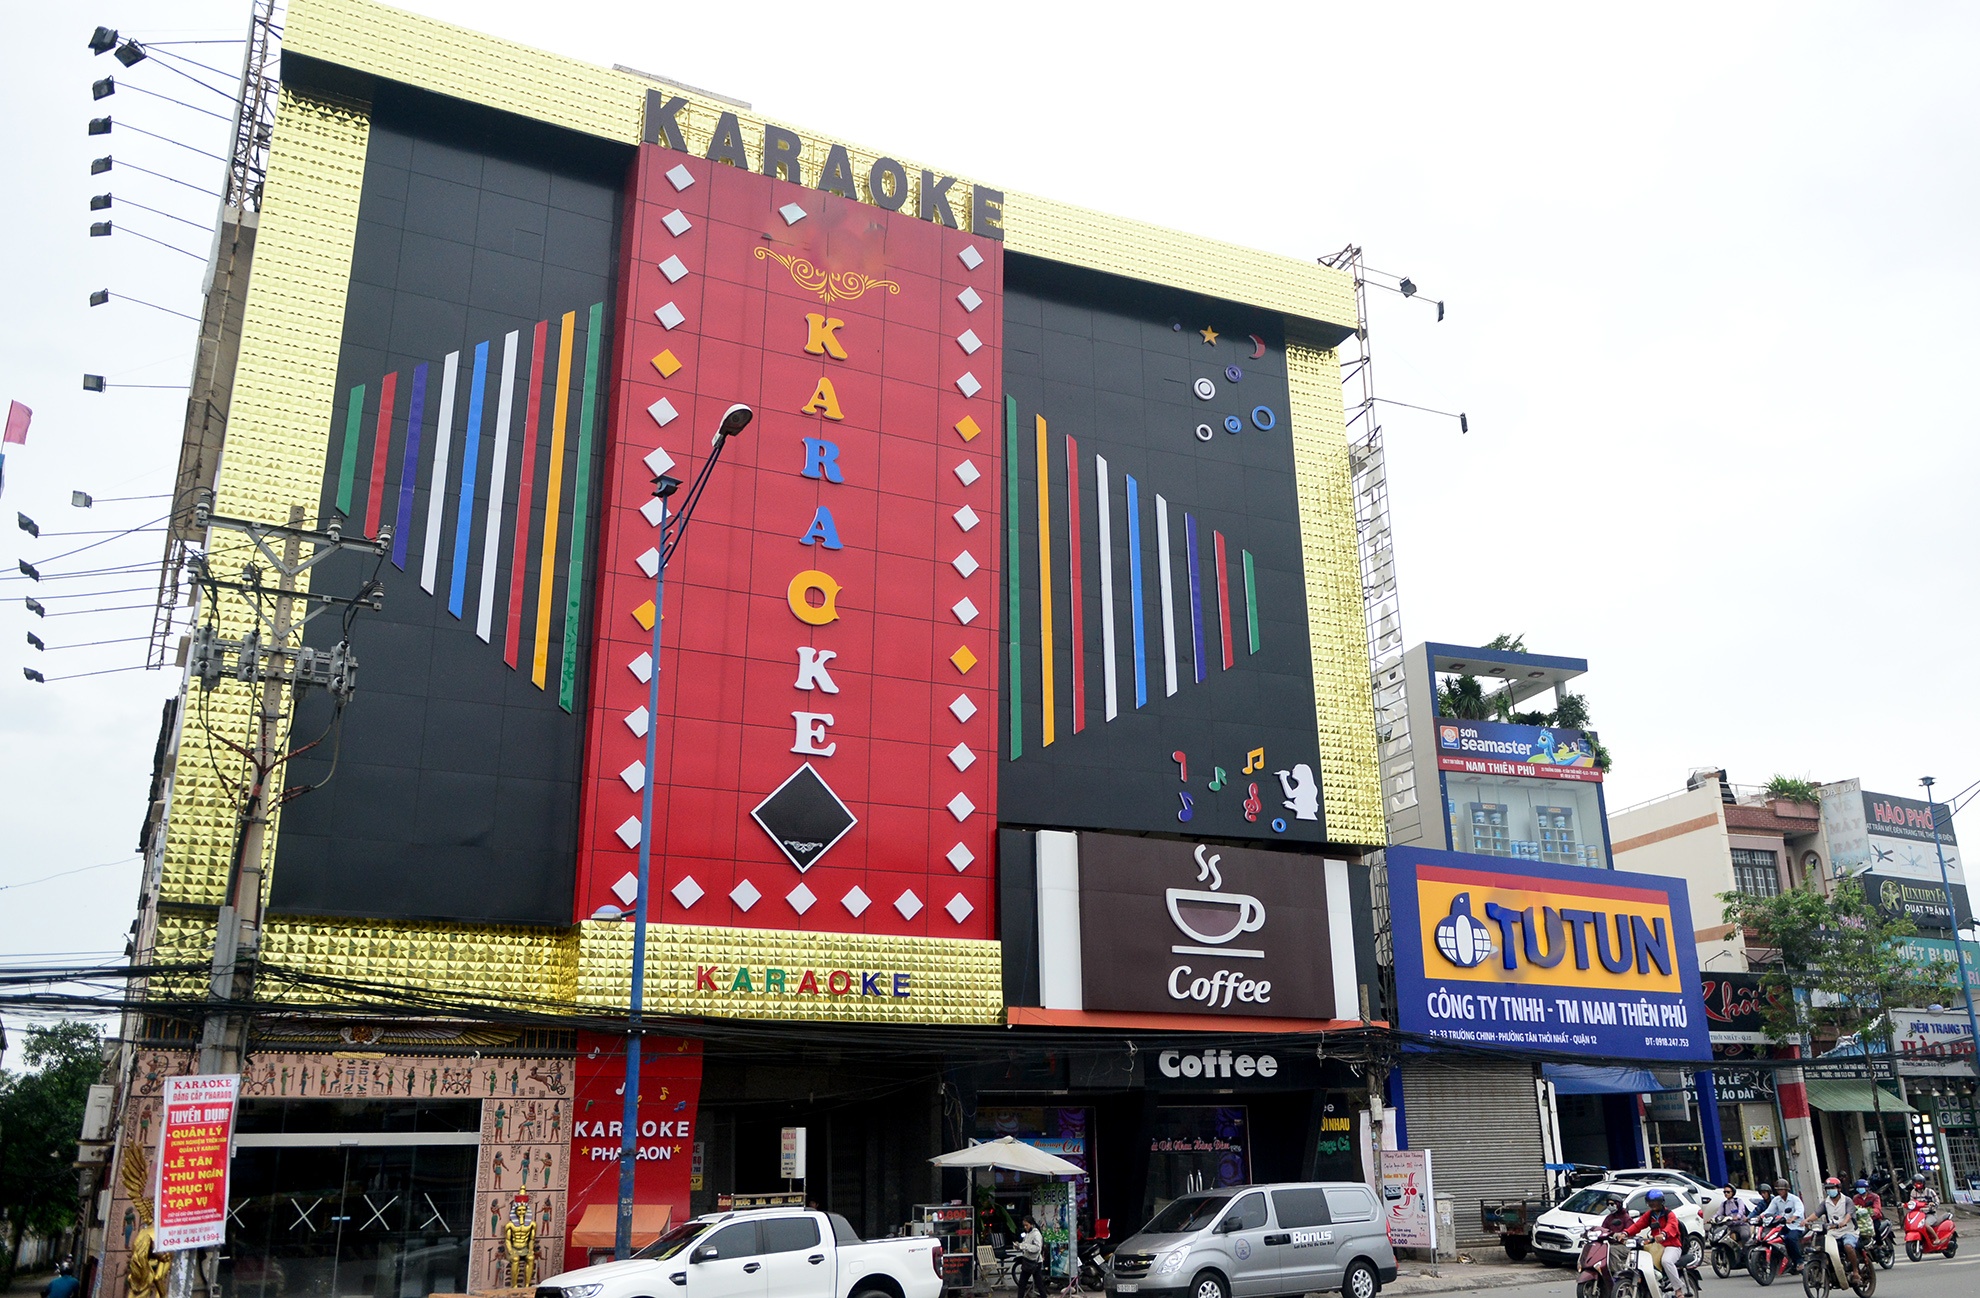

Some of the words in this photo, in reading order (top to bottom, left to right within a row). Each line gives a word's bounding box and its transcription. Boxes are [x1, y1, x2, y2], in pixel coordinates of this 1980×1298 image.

[642, 88, 1004, 241] KARAOKE
[786, 312, 848, 757] KARAOKE
[1460, 728, 1478, 738] sơn
[1461, 739, 1532, 755] seamaster
[1465, 761, 1486, 772] NAM
[1487, 761, 1515, 775] THIÊN
[1517, 763, 1535, 776] PHÚ
[1873, 800, 1905, 825] HÀO
[1905, 806, 1934, 830] PHỐ
[1903, 827, 1917, 836] TRANG
[1484, 902, 1673, 976] TUTUN
[696, 965, 911, 998] KARAOKE
[1168, 965, 1271, 1008] Coffee
[1427, 986, 1475, 1019] CÔNG
[1477, 995, 1498, 1020] TY
[1501, 996, 1546, 1022] TNHH
[1556, 999, 1580, 1024] TM
[1581, 1000, 1617, 1025] NAM
[1618, 997, 1660, 1027] THIÊN
[1661, 999, 1687, 1028] PHÚ
[1910, 1020, 1929, 1034] ĐÈN
[1930, 1023, 1960, 1035] TRANG
[1961, 1024, 1974, 1035] TR
[1448, 1028, 1475, 1041] TRƯỜNG
[1476, 1031, 1496, 1041] CHINH
[1525, 1031, 1538, 1043] TÂN
[1553, 1031, 1569, 1044] NHẤT
[1573, 1033, 1590, 1046] QUẬN
[1590, 1036, 1597, 1045] 12
[1159, 1049, 1278, 1078] Coffee
[174, 1079, 232, 1090] KARAOKE
[1719, 1077, 1727, 1085] &
[1722, 1088, 1735, 1099] ÁO
[1738, 1088, 1754, 1099] DÀI
[171, 1106, 201, 1124] TUYỂN
[204, 1108, 229, 1124] DỤNG
[574, 1121, 690, 1138] KAROKE
[1329, 1117, 1350, 1131] NHAU
[172, 1126, 206, 1139] QUẢN
[209, 1125, 222, 1136] LÝ
[591, 1146, 671, 1161] PHAAON
[170, 1156, 185, 1168] LỄ
[189, 1156, 213, 1166] TÂN
[169, 1172, 195, 1181] THU
[168, 1184, 202, 1195] PHỤC
[204, 1183, 214, 1193] VỤ
[168, 1198, 193, 1209] TẠP
[196, 1197, 208, 1207] VỤ
[163, 1237, 181, 1246] 094
[184, 1236, 200, 1244] 444
[1293, 1230, 1332, 1245] Bonus
